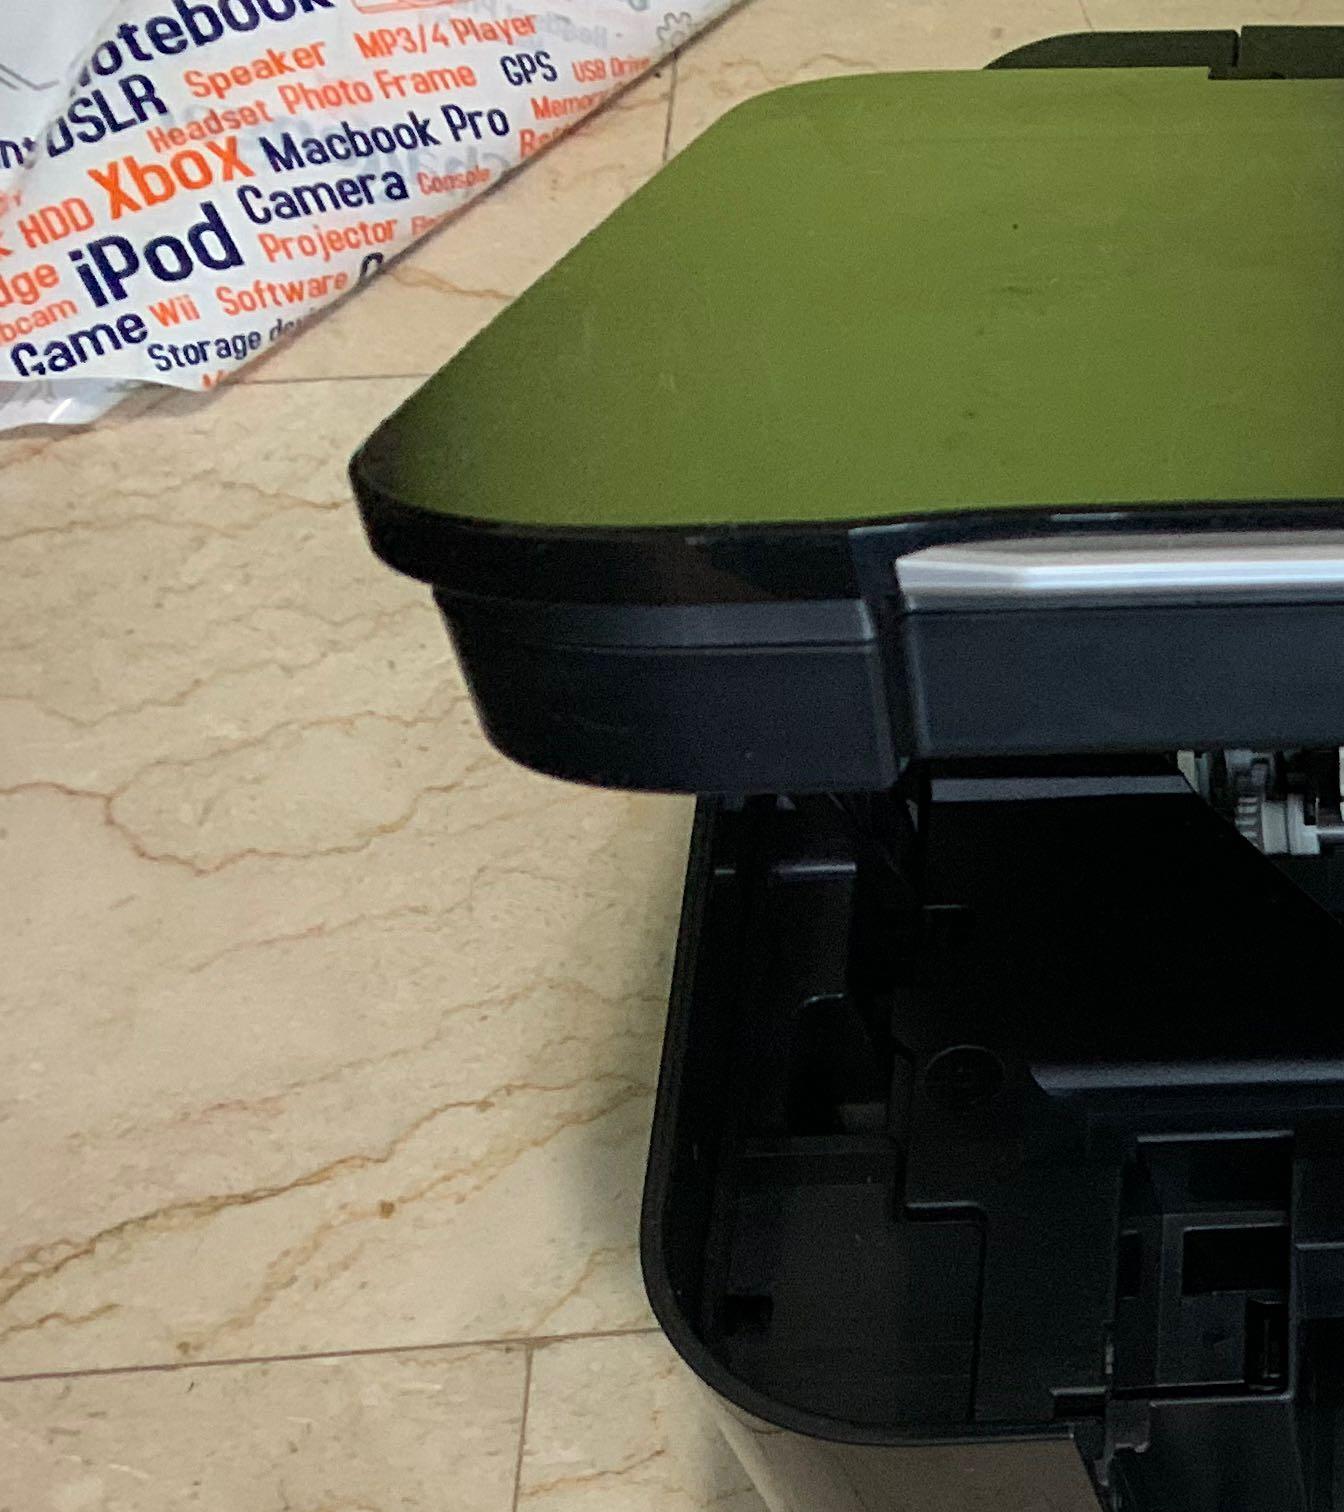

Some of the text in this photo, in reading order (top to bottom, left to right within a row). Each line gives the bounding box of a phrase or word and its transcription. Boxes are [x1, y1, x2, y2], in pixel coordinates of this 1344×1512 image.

[353, 14, 537, 60] MP3/4 Player
[183, 41, 326, 100] Speaker
[278, 65, 476, 116] Photo Frame
[500, 50, 558, 86] GPS
[571, 58, 607, 84] USB
[46, 74, 168, 158] DSLR
[148, 99, 274, 153] Headset
[259, 110, 441, 173] Macbook
[440, 103, 510, 143] Pro
[237, 171, 411, 226] Camera
[416, 165, 491, 196] Console
[17, 197, 95, 249] HDD
[258, 218, 398, 263] Projector
[68, 200, 245, 308] iPod
[149, 294, 201, 328] Wii
[215, 271, 349, 317] Software
[10, 312, 149, 377] Game
[148, 330, 262, 372] Storage
